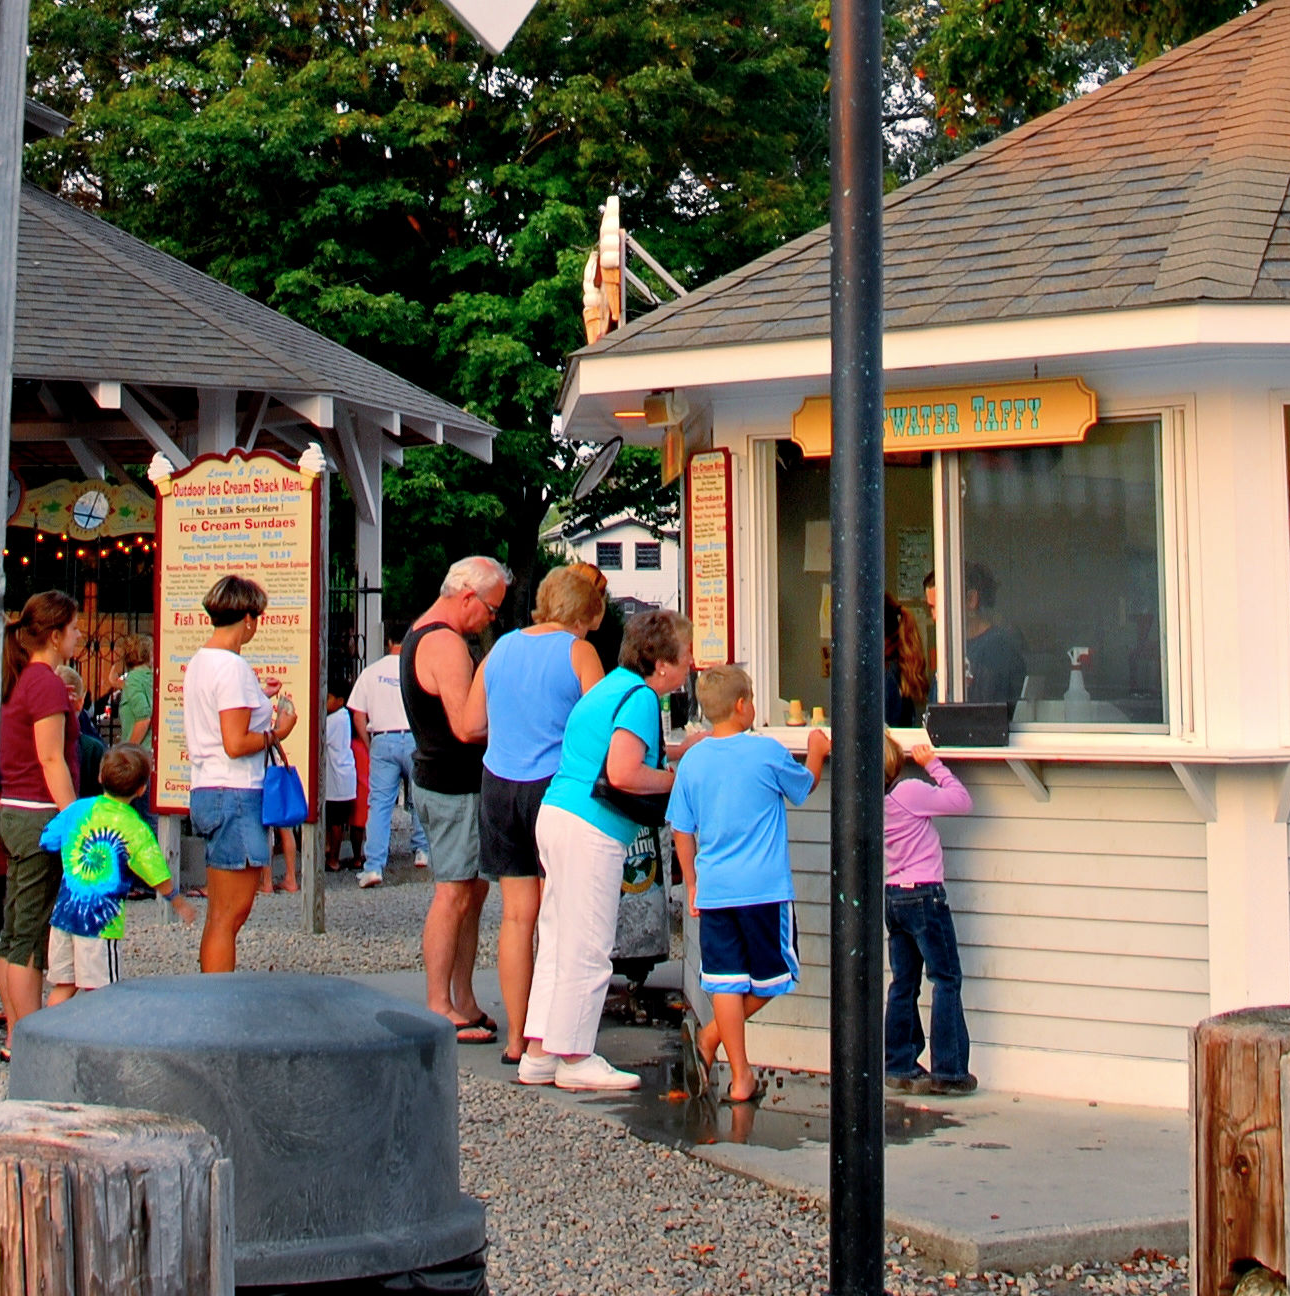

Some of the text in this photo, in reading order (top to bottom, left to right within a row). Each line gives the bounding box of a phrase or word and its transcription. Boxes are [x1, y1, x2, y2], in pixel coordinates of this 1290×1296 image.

[173, 483, 206, 497] Outdoor
[209, 482, 221, 496] Ice
[224, 480, 250, 494] Cream
[254, 478, 278, 493] Shack
[196, 507, 205, 515] No
[207, 507, 217, 515] Ice
[220, 506, 233, 514] Milk
[236, 505, 260, 513] Served
[263, 504, 278, 512] Here
[180, 518, 295, 532] Ice Cream Sundaes
[174, 613, 299, 625] Fish Ta Frenzys
[168, 684, 183, 693] Con
[165, 782, 190, 791] Carou
